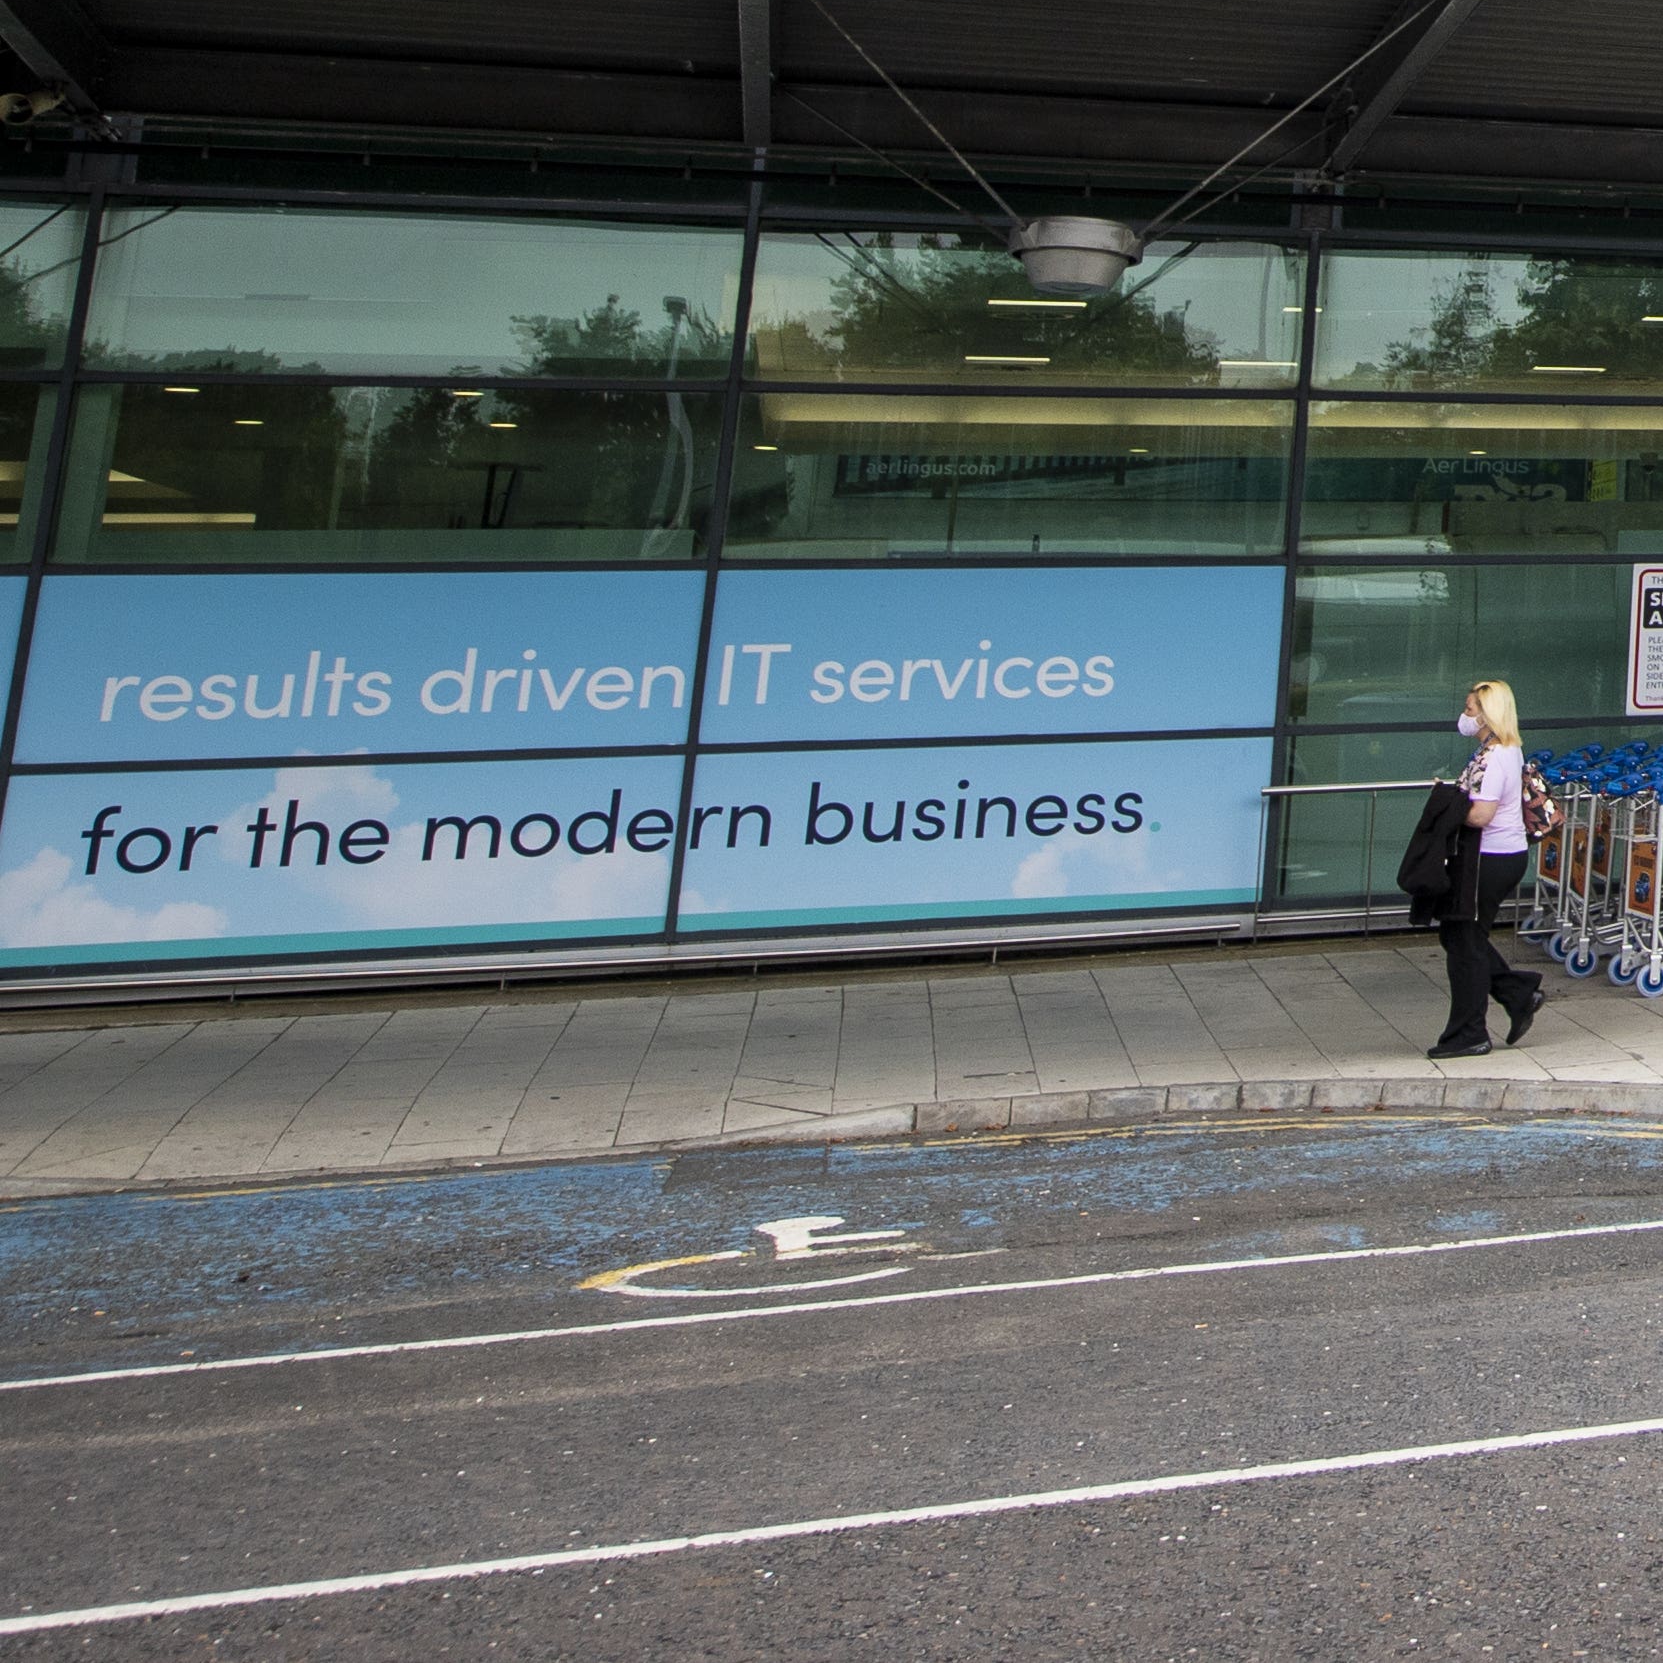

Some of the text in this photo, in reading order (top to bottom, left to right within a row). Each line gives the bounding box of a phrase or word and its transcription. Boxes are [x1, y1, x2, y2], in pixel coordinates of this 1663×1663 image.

[866, 460, 996, 478] aerlingus.com
[1422, 458, 1459, 474] Aer
[1647, 663, 1660, 671] ON
[101, 640, 1115, 723] results driven IT services
[1646, 672, 1663, 680] SIDE
[81, 779, 1162, 876] for the modern business.
